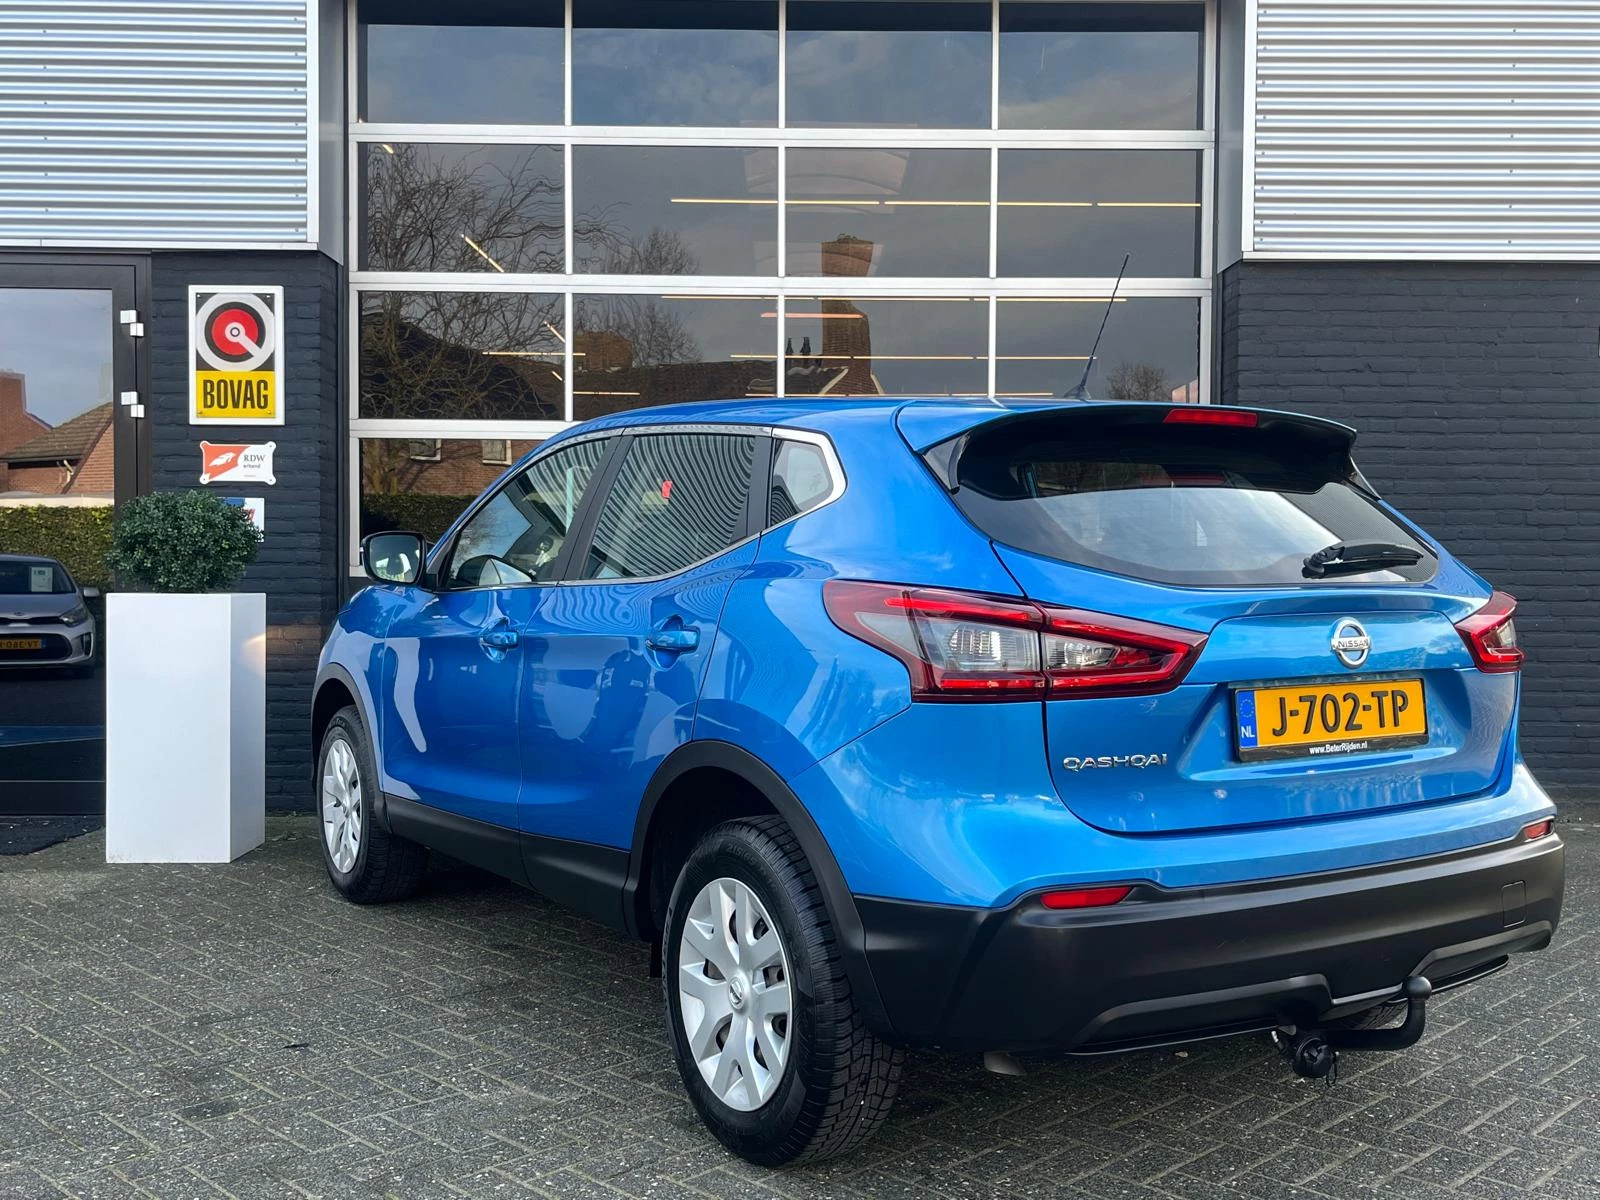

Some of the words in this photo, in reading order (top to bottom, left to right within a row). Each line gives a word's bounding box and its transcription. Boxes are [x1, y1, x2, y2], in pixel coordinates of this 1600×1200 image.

[202, 378, 269, 410] BOVAG
[243, 454, 266, 462] RDW
[1338, 638, 1369, 648] NISSAN
[1272, 689, 1409, 737] J-702-TP
[1240, 725, 1256, 738] NL
[1309, 740, 1368, 755] www.BeterRijden.nl
[1063, 753, 1168, 772] QASHQAI
